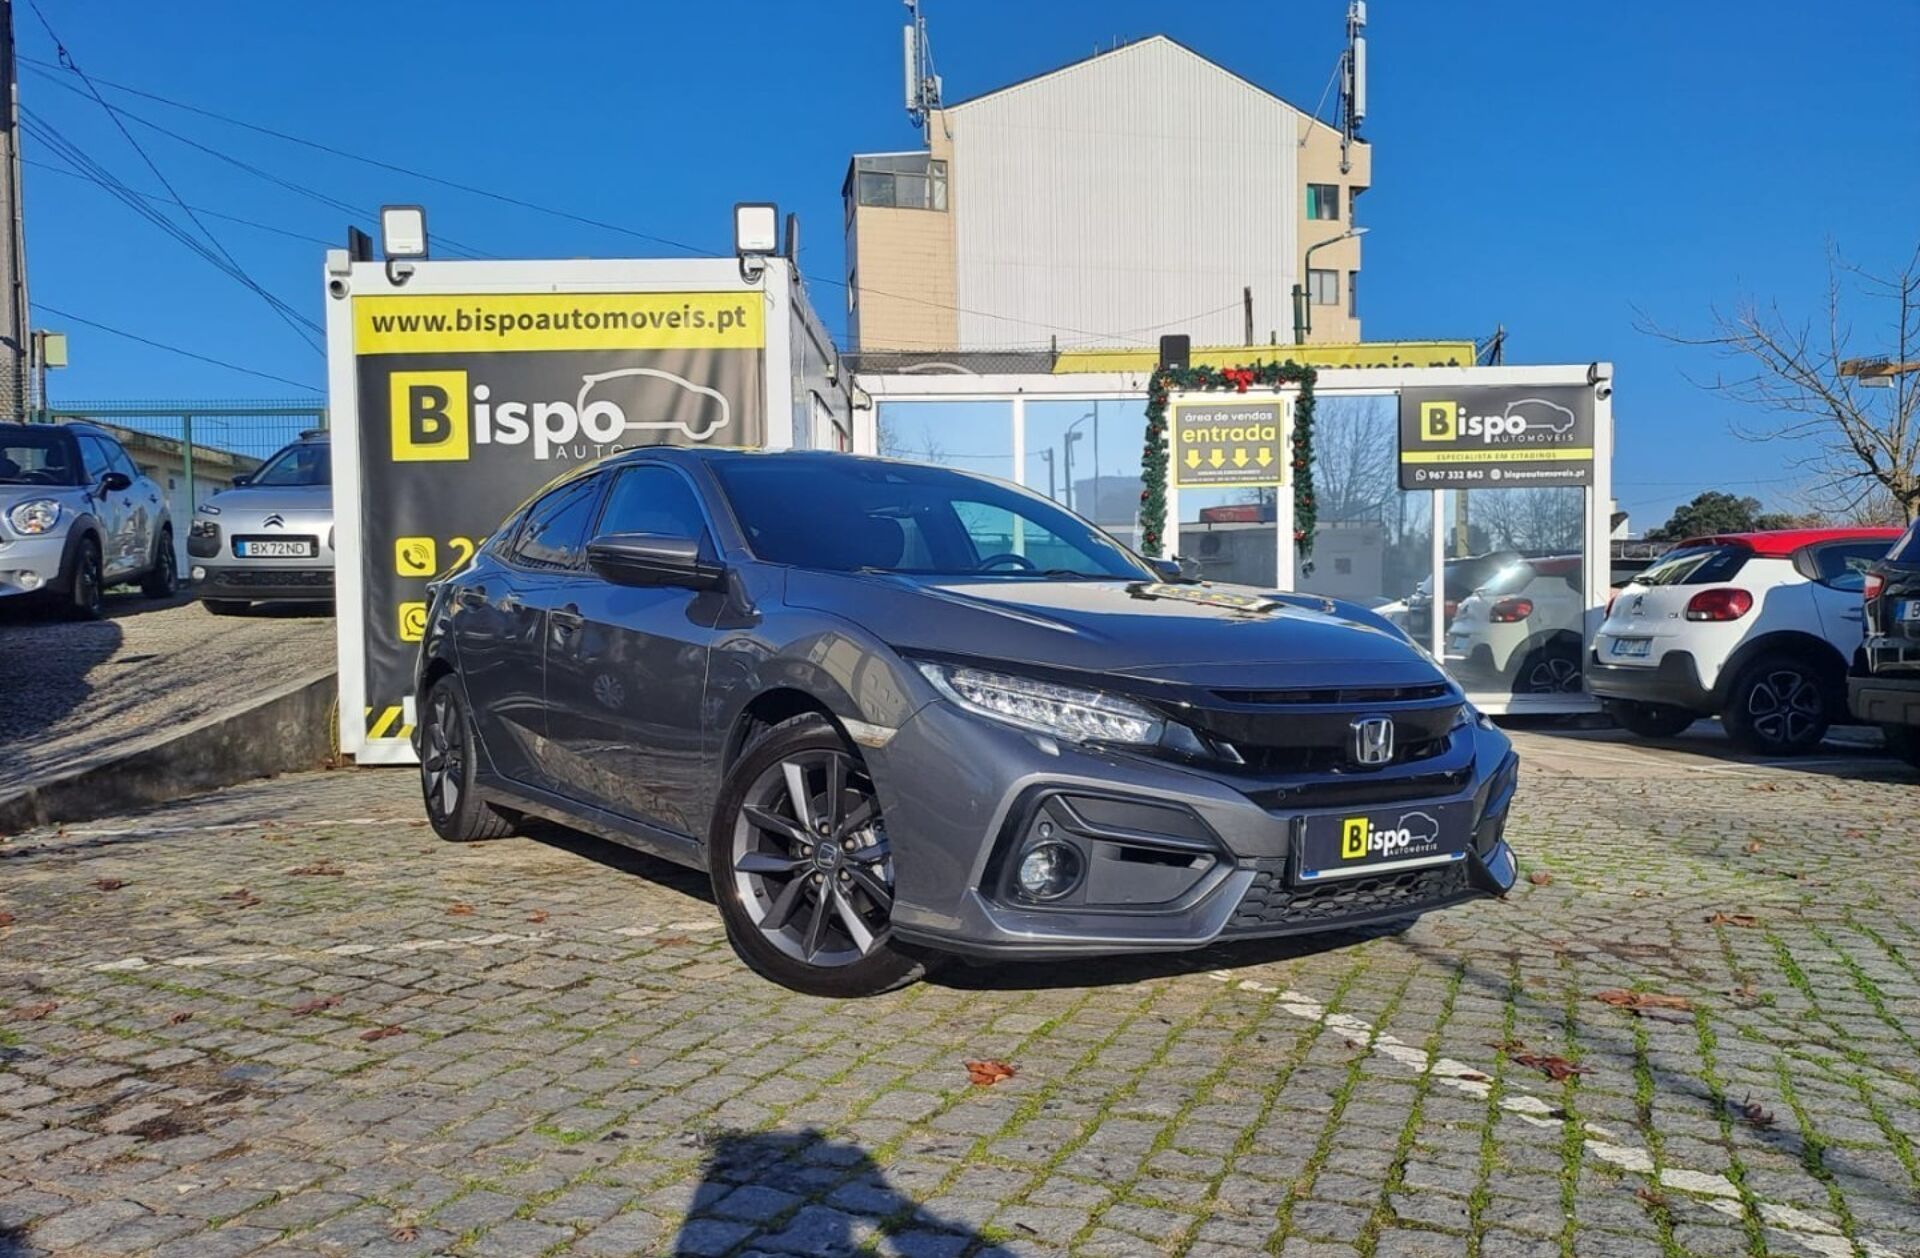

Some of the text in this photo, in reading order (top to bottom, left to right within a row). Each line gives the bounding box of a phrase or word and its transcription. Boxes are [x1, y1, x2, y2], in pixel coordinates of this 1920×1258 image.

[371, 303, 747, 337] www.bispoautomoveis.pt
[407, 384, 627, 461] Bispo
[1214, 411, 1229, 421] de
[1231, 410, 1273, 421] vendas
[1429, 407, 1527, 444] Bispo
[1182, 423, 1276, 443] entrada
[1428, 470, 1445, 480] 967
[1349, 823, 1410, 857] Bispo
